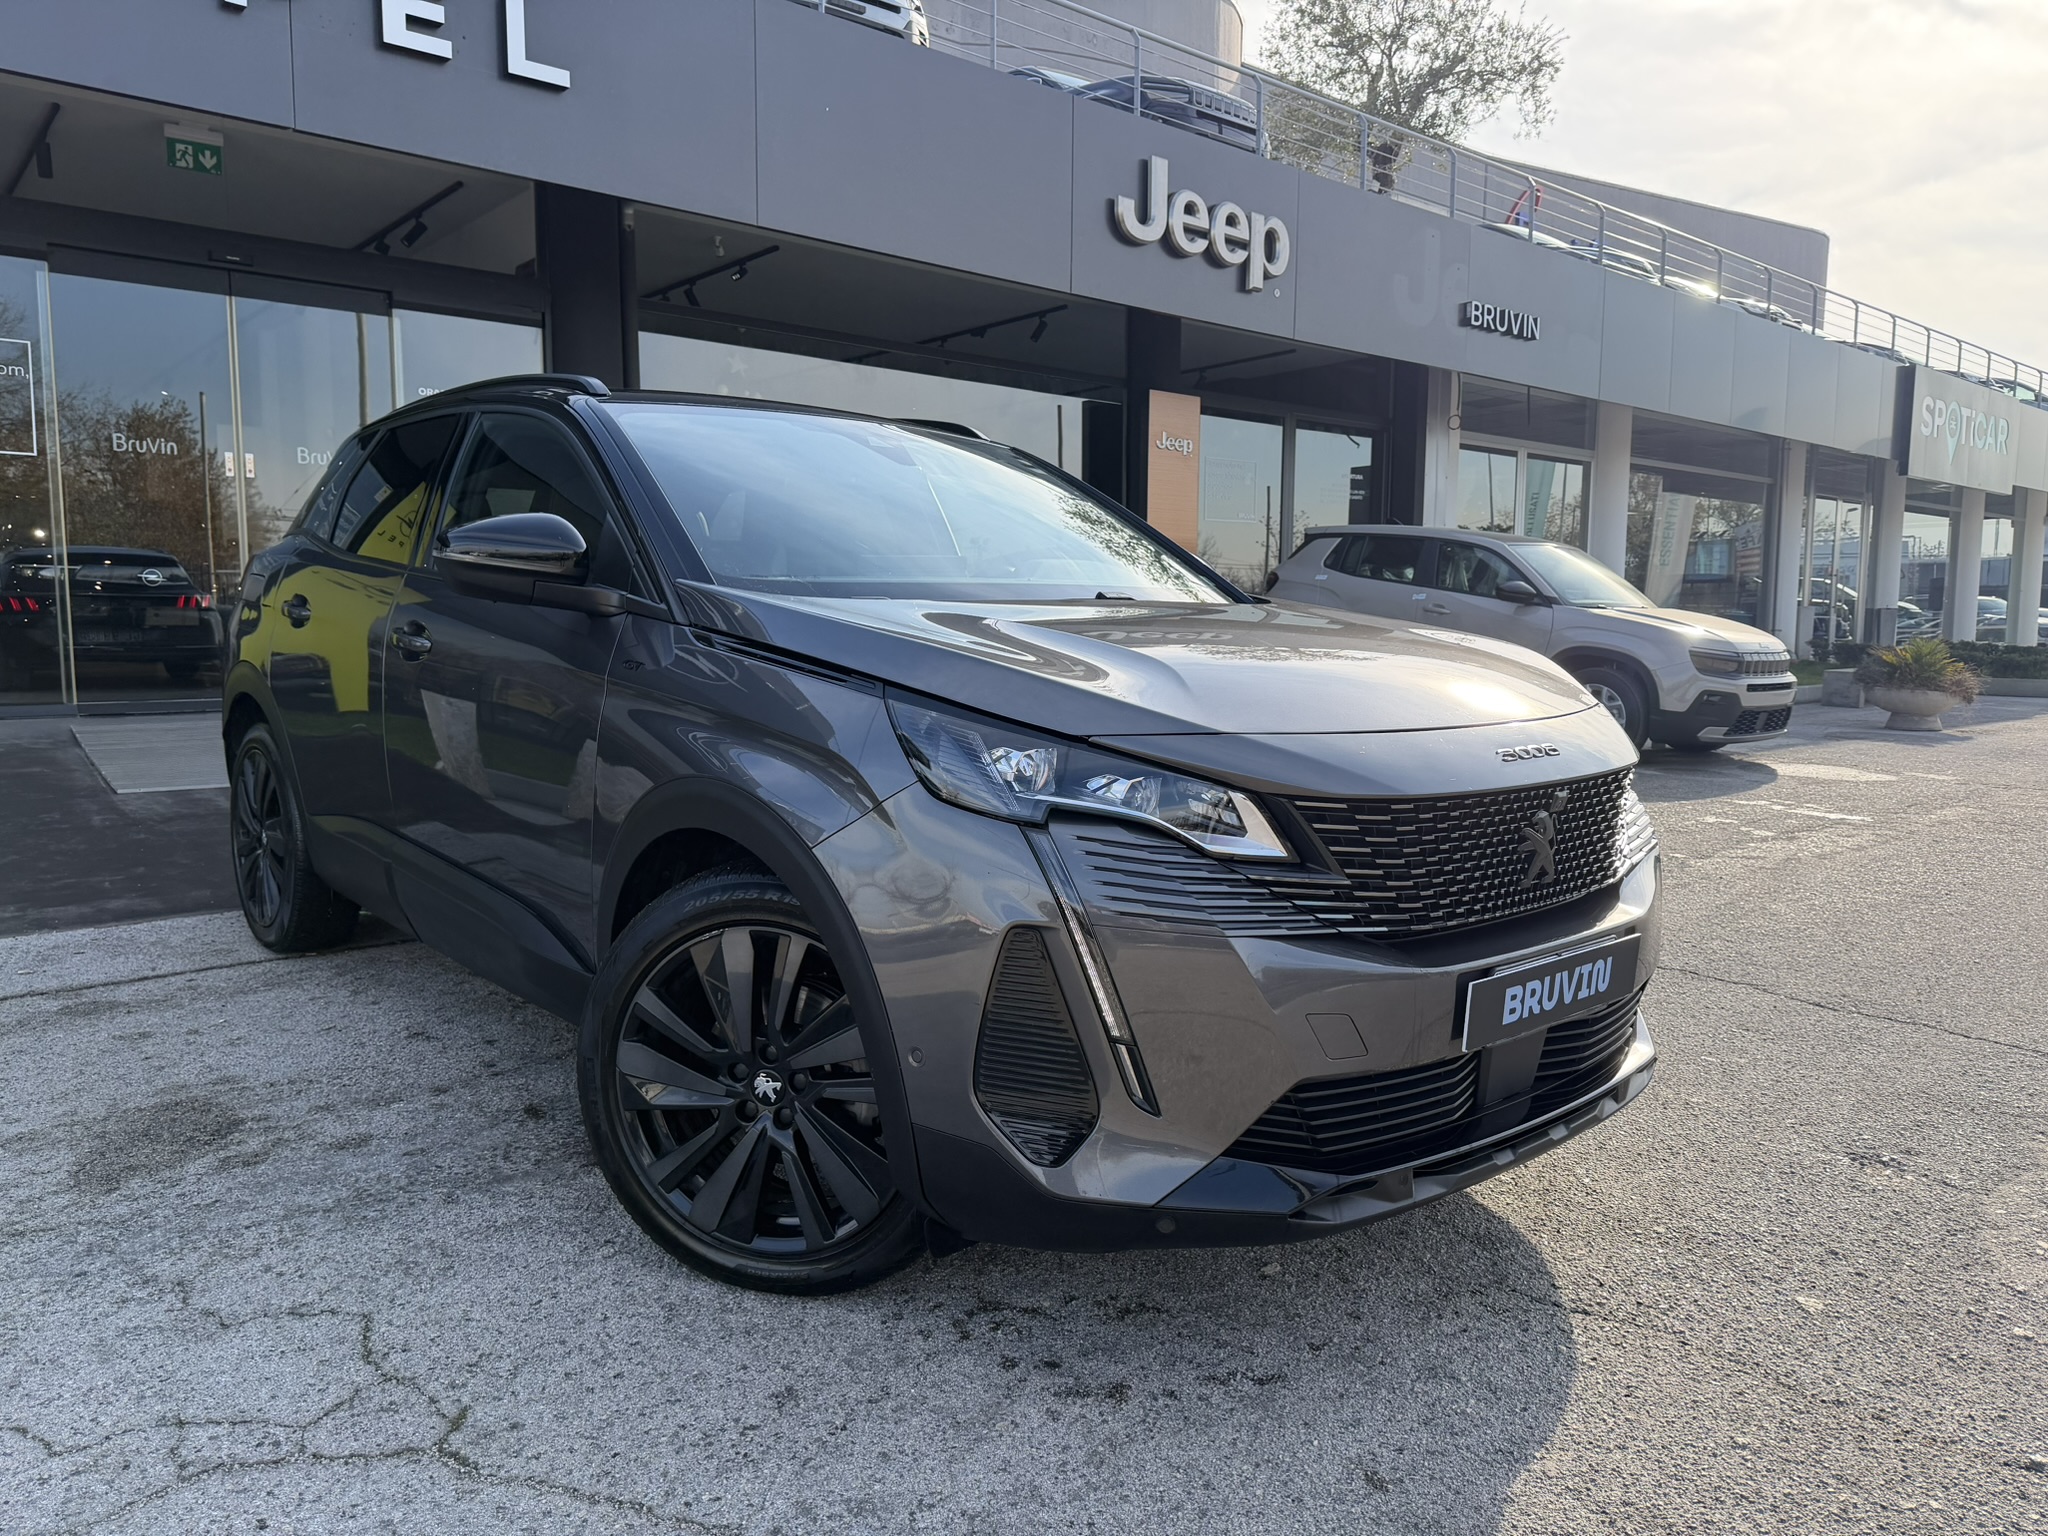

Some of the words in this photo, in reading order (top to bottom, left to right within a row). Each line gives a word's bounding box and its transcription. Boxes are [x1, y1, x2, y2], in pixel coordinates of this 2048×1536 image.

[1114, 155, 1290, 292] Jeep
[1470, 301, 1541, 340] BRUVIN
[112, 433, 178, 455] BruVin
[1156, 431, 1193, 456] Jeep
[1496, 743, 1560, 762] 3008
[1502, 956, 1613, 1025] BRUVIN
